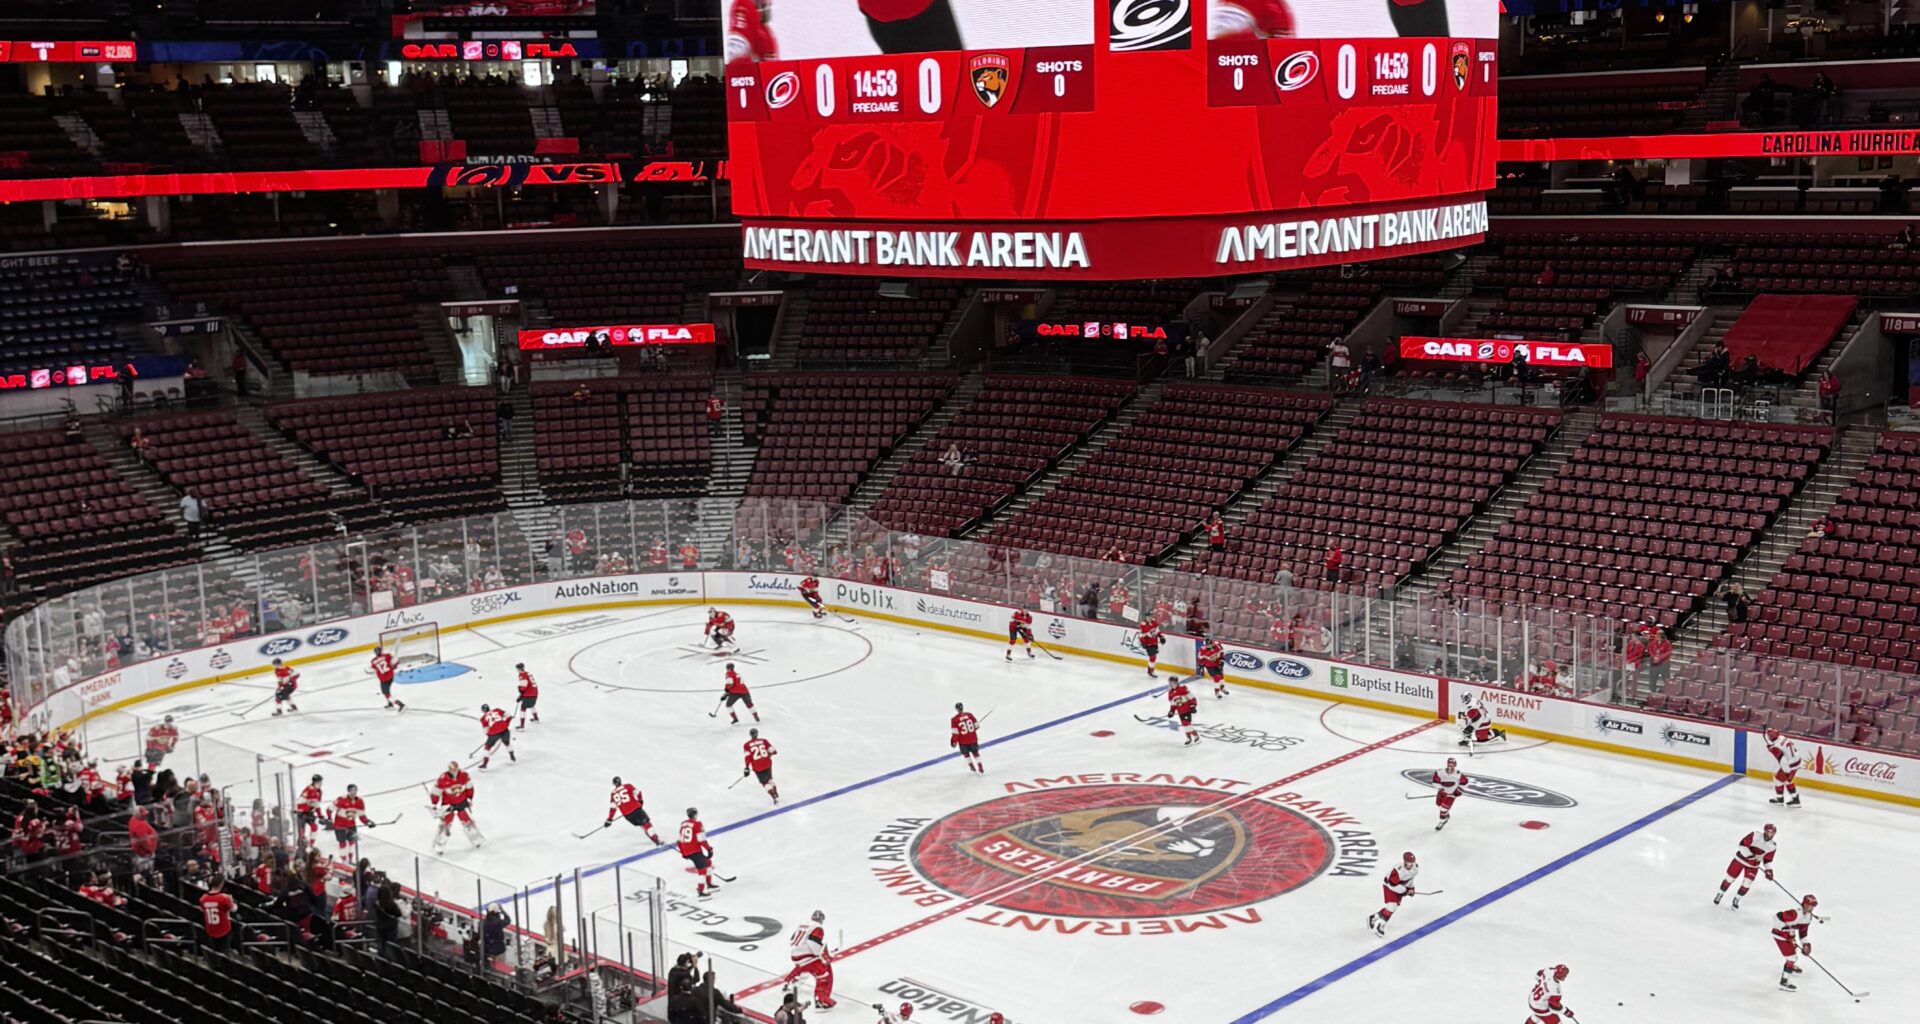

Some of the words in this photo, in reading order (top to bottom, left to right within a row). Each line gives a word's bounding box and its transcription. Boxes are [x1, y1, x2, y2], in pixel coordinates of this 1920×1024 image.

[402, 43, 458, 58] CAR
[527, 43, 577, 58] FLA
[1036, 61, 1082, 73] SHOTS
[1218, 56, 1259, 67] SHOTS
[1375, 52, 1409, 80] 14:53
[1422, 43, 1436, 96] 0
[1234, 68, 1244, 91] 0
[1338, 44, 1356, 99] 0
[731, 77, 755, 87] SHOTS
[816, 64, 835, 117] 0
[853, 70, 898, 99] 14:53
[919, 58, 941, 113] 0
[1054, 74, 1065, 97] 0
[1373, 85, 1409, 95] PREGAME
[740, 88, 747, 108] 1
[853, 101, 898, 113] PREGAME
[1761, 135, 1841, 153] CAROLINA
[541, 164, 610, 183] VS
[1215, 215, 1378, 263] AMERANT
[1379, 207, 1438, 247] BANK
[1439, 201, 1488, 239] ARENA
[744, 227, 872, 264] AMERANT
[876, 231, 963, 267] BANK
[967, 232, 1090, 268] ARENA
[28, 256, 59, 267] BEER
[1397, 302, 1410, 313] 116
[1631, 310, 1645, 321] 117
[1036, 323, 1079, 336] CAR
[1130, 326, 1167, 339] FLA
[1885, 318, 1902, 331] 118
[542, 331, 588, 346] CAR
[648, 328, 692, 340] FLA
[1423, 342, 1471, 356] CAR
[1535, 347, 1584, 361] FLA
[555, 580, 638, 599] AutoNation
[748, 574, 796, 590] Sandals
[471, 593, 505, 608] OMEGA
[503, 591, 522, 605] XL
[837, 583, 896, 611] Publix
[472, 603, 503, 615] SPORT
[267, 639, 296, 655] Ford
[314, 630, 346, 647] Ford
[1229, 652, 1257, 669] Ford
[1275, 660, 1304, 678] Ford
[80, 673, 123, 696] AMERANT
[1351, 674, 1391, 692] Baptist
[1394, 681, 1434, 700] Health
[90, 691, 112, 706] BANK
[1480, 690, 1543, 711] AMERANT
[1496, 708, 1526, 722] BANK
[959, 719, 975, 735] 38
[1203, 723, 1304, 746] SPORT
[1606, 720, 1620, 729] Air
[1620, 722, 1640, 733] Pros
[1671, 732, 1686, 740] Air
[1686, 734, 1706, 744] Pros
[750, 745, 772, 761] 26
[1004, 773, 1251, 794] AMERANT
[1267, 791, 1362, 828] BANK
[1328, 829, 1379, 877] ARENA
[868, 817, 933, 862] ARENA
[983, 840, 1164, 893] PANTHERS
[871, 864, 955, 907] BANK
[205, 907, 220, 925] 16
[967, 908, 1262, 936] AMERANT
